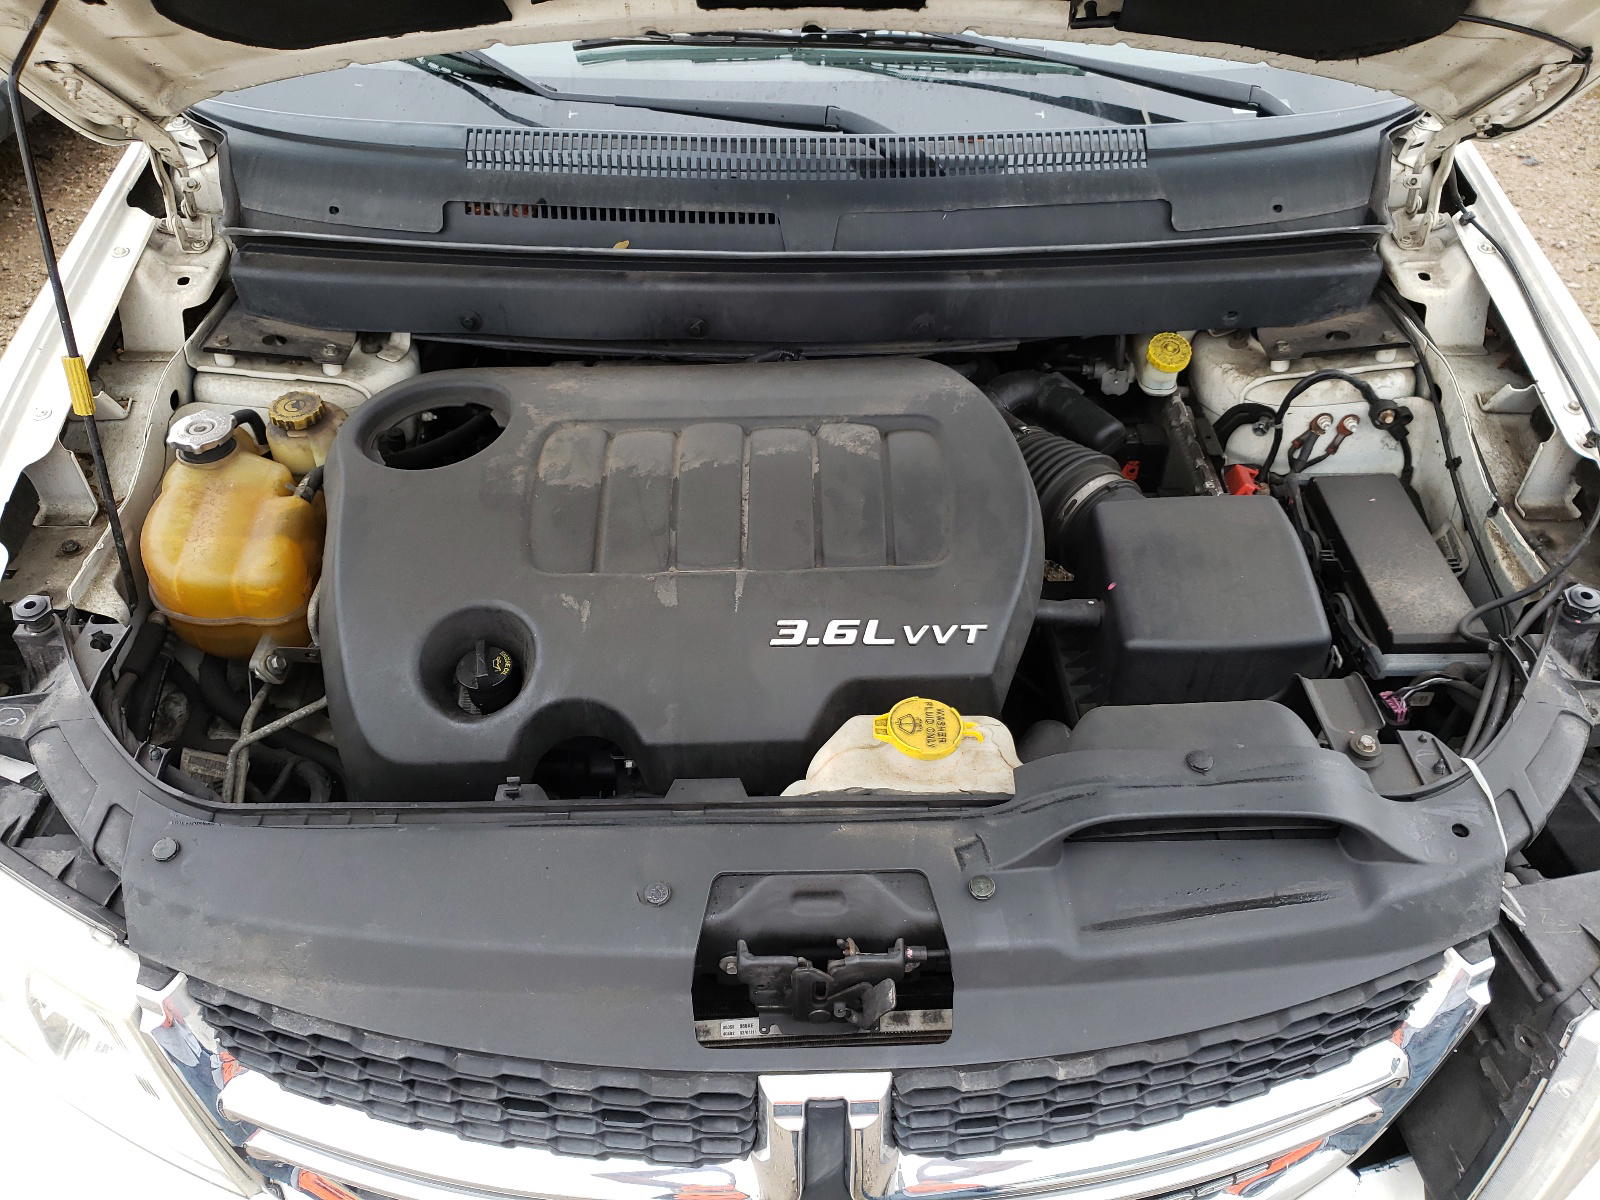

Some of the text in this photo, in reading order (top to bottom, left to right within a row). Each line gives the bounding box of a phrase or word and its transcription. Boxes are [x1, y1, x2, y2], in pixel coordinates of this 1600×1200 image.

[769, 619, 989, 647] 3.6L VVT
[924, 701, 936, 748] FLUID ONLY
[936, 708, 947, 744] WASHER
